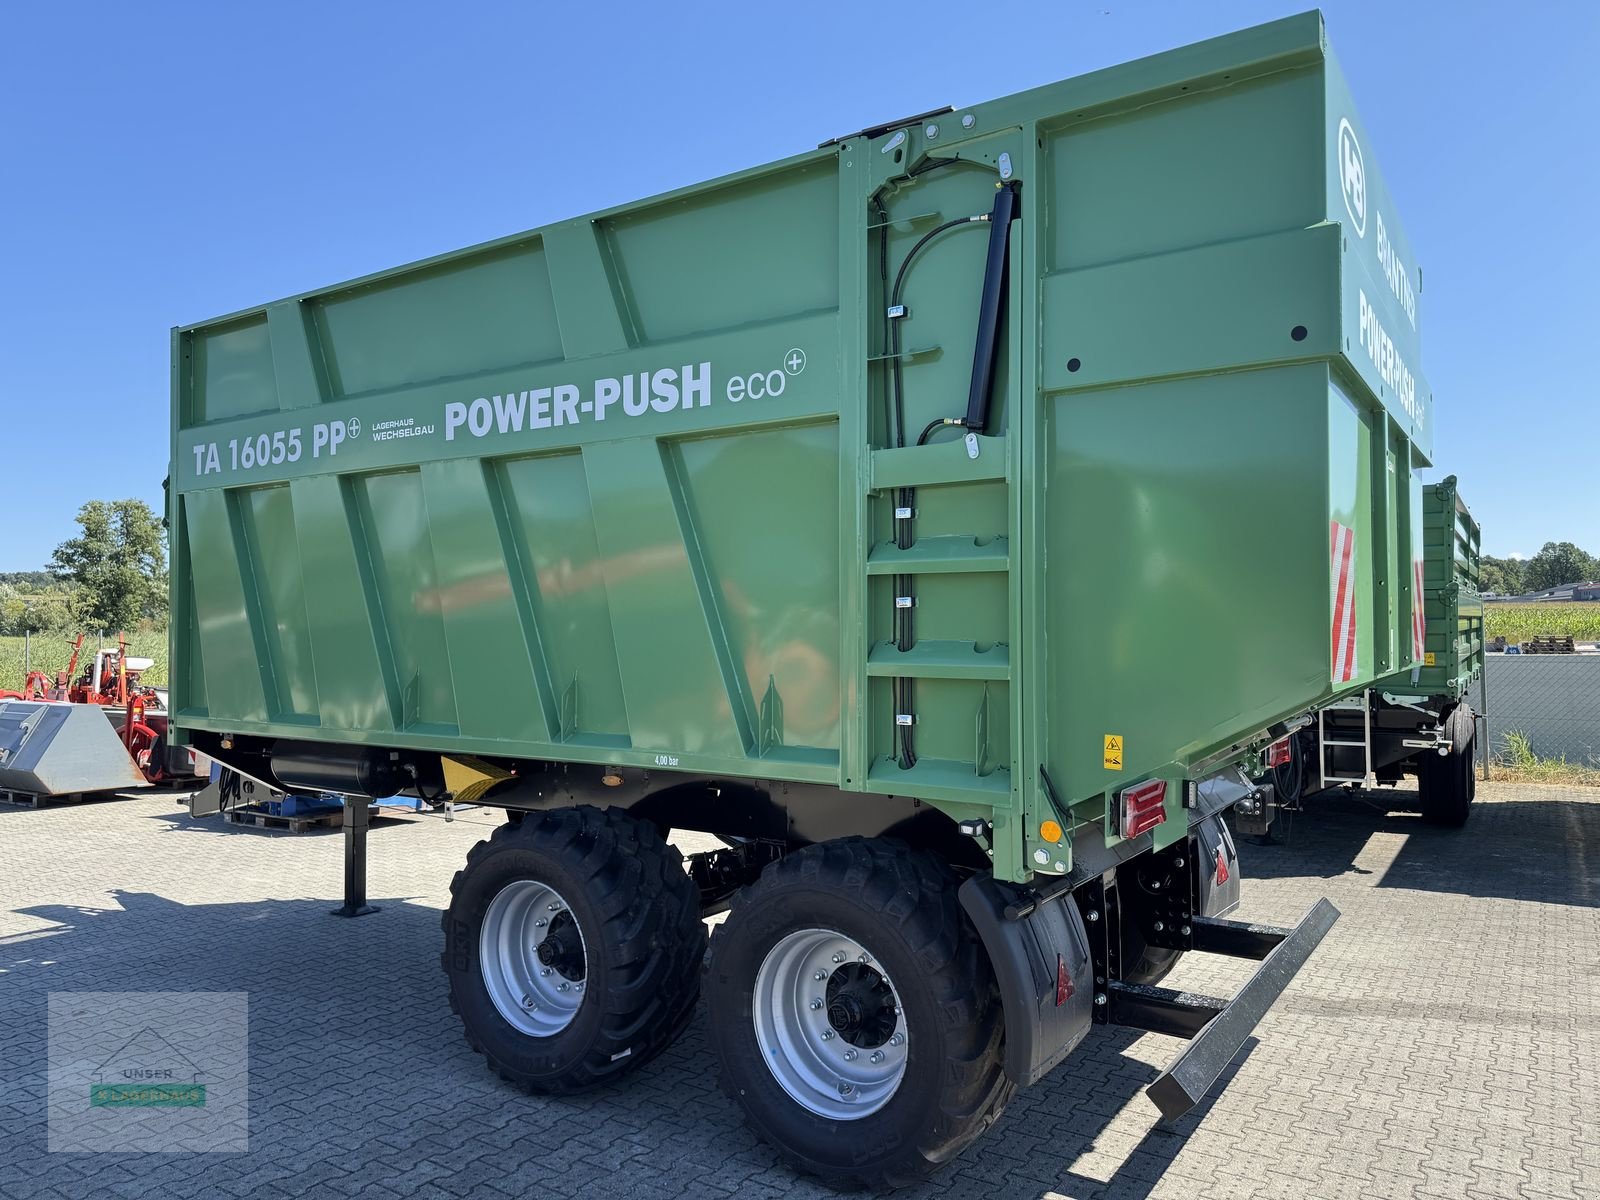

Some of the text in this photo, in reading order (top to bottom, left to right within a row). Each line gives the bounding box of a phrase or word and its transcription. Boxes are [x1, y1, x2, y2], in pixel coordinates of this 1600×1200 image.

[1376, 210, 1415, 332] BRANTNER
[1359, 288, 1415, 420] POWER-PUSH
[372, 418, 414, 431] LAGERHAUS
[445, 361, 711, 441] POWER-PUSH
[193, 443, 221, 475] TA
[228, 427, 302, 470] 16055
[373, 424, 435, 442] WECHSELGAU
[655, 755, 679, 766] 4,00 bar
